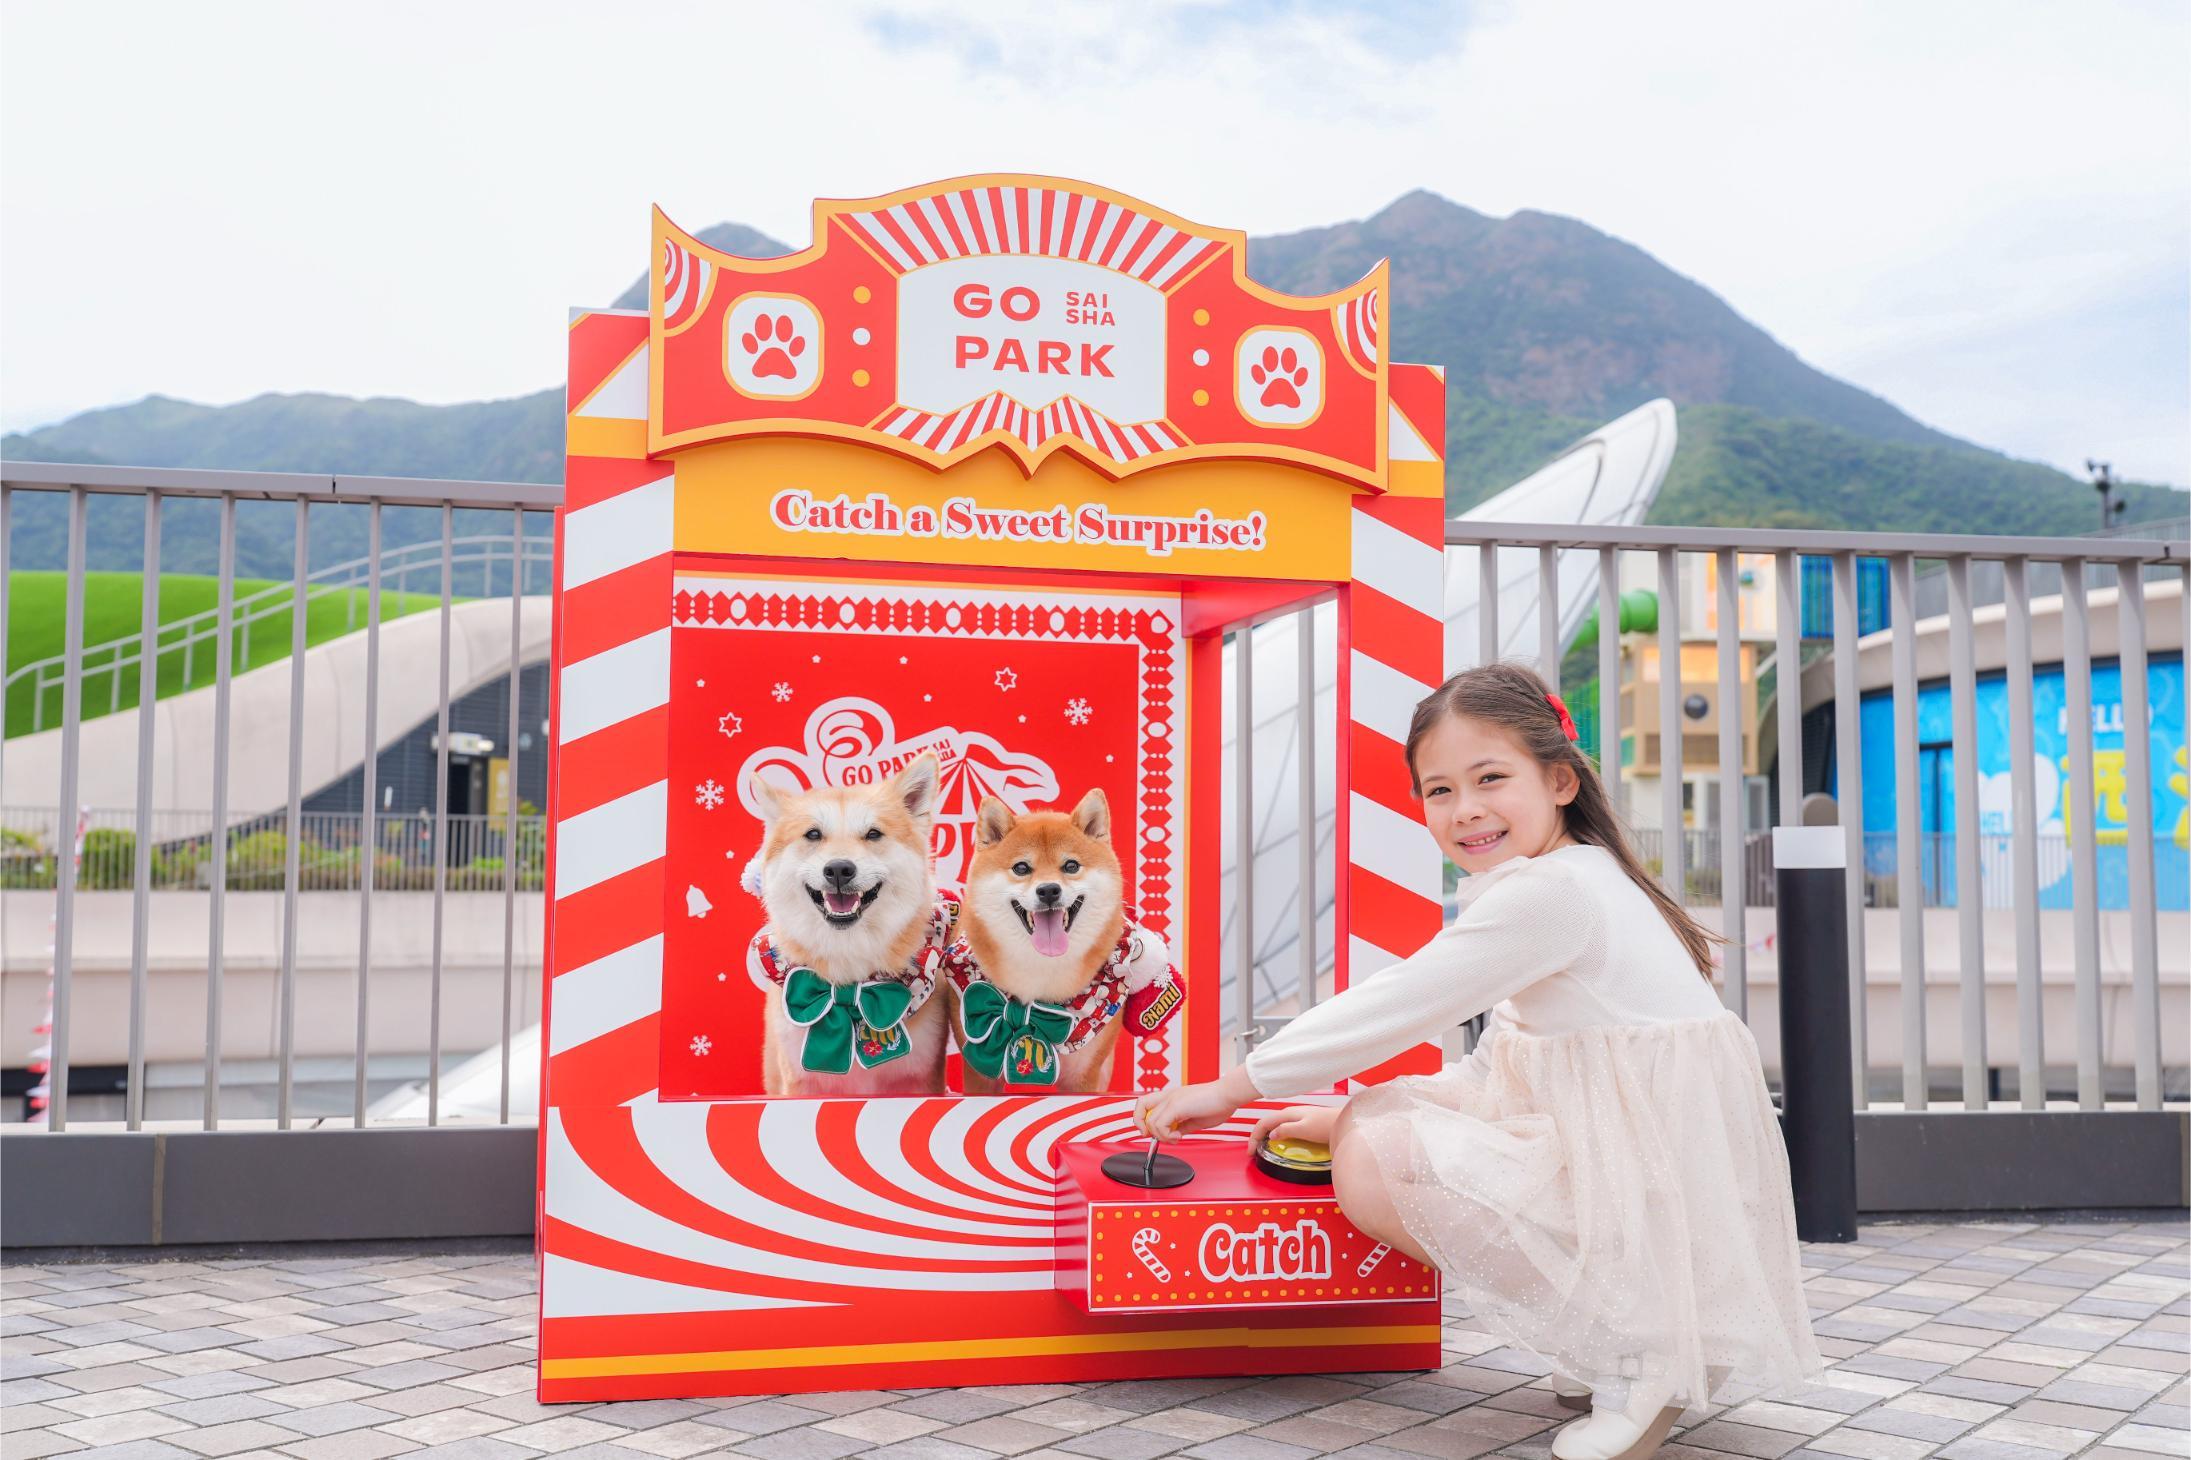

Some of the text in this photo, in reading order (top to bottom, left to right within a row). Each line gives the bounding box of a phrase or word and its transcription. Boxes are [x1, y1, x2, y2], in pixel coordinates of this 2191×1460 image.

[953, 283, 1041, 322] GO
[1066, 291, 1109, 309] SAI
[1066, 309, 1116, 326] SHA
[955, 335, 1116, 378] PARK
[775, 494, 1262, 551] Catch a Sweet Surprise!
[842, 745, 929, 787] GO PAR
[1203, 1225, 1327, 1277] Catch
